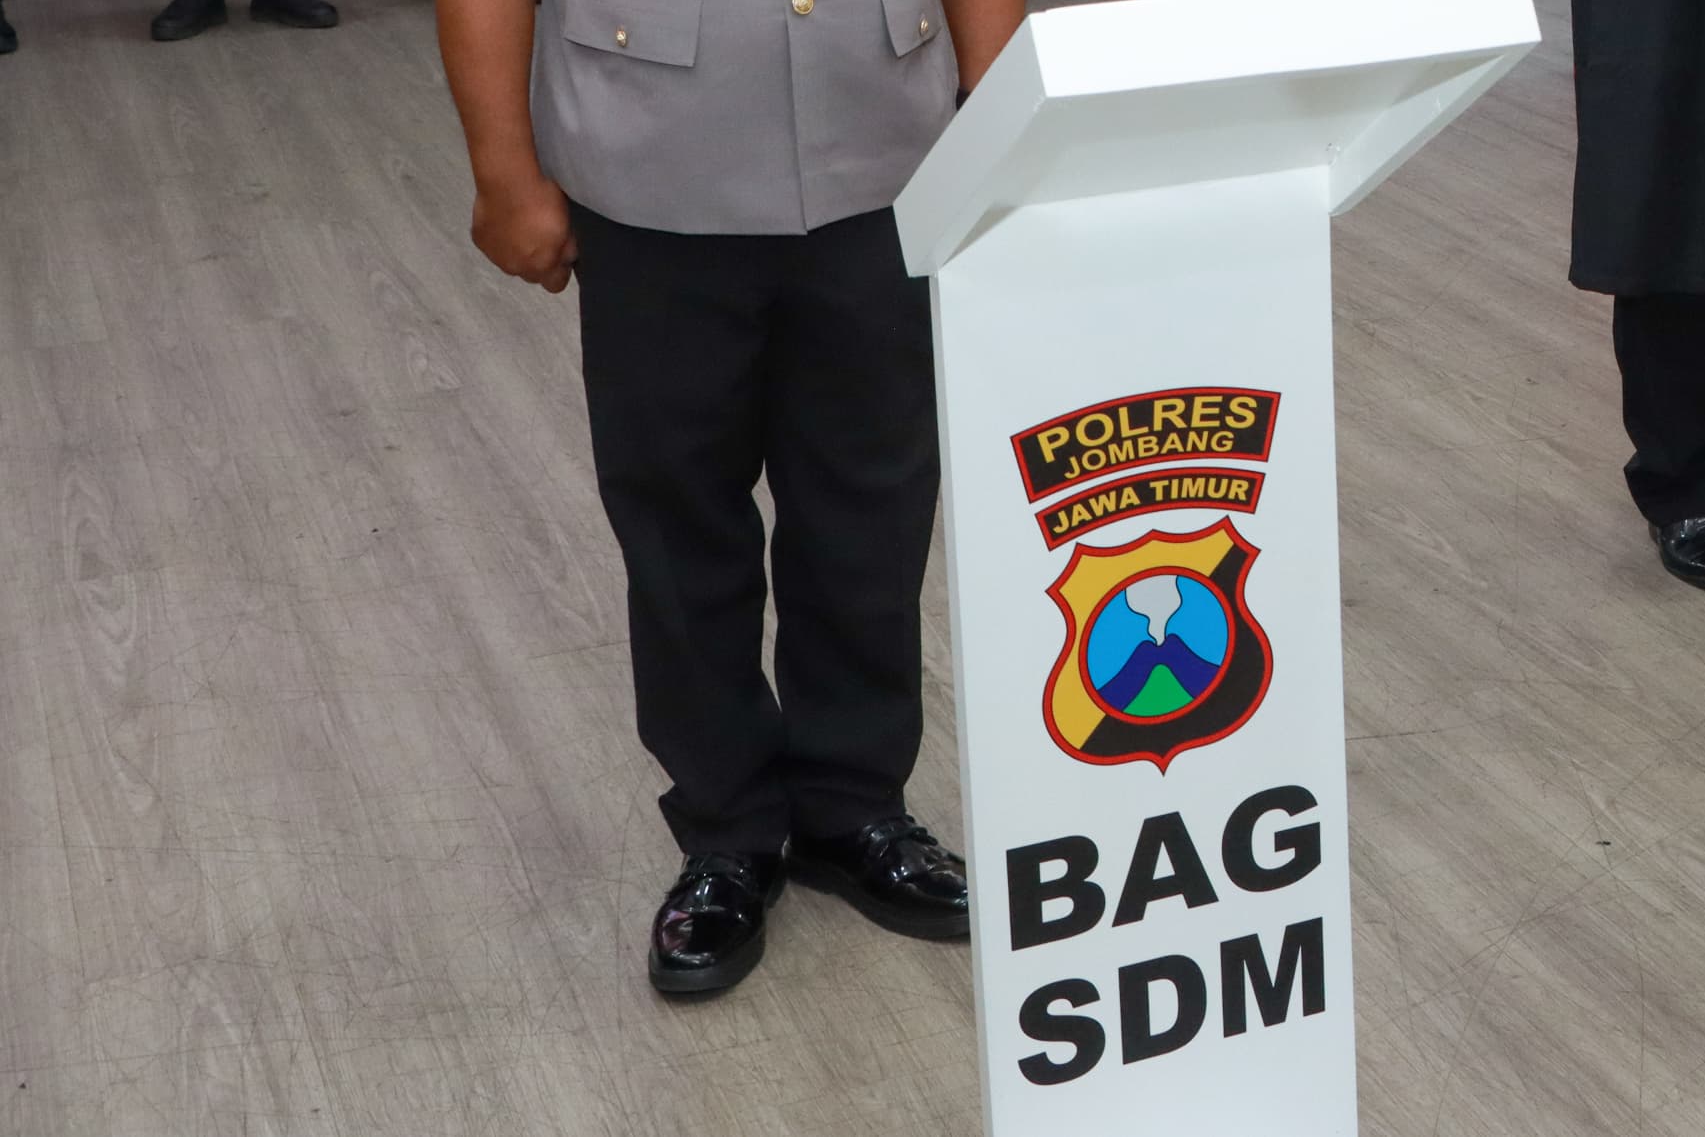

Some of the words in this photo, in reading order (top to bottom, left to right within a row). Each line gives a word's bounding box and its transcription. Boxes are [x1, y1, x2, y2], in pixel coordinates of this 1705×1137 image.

[1036, 395, 1259, 464] POLRES
[1063, 430, 1235, 480] JOMBANG
[1050, 486, 1140, 535] JAWA
[1149, 476, 1250, 502] TIMUR
[1005, 783, 1322, 952] BAG
[1016, 916, 1326, 1086] SDM
